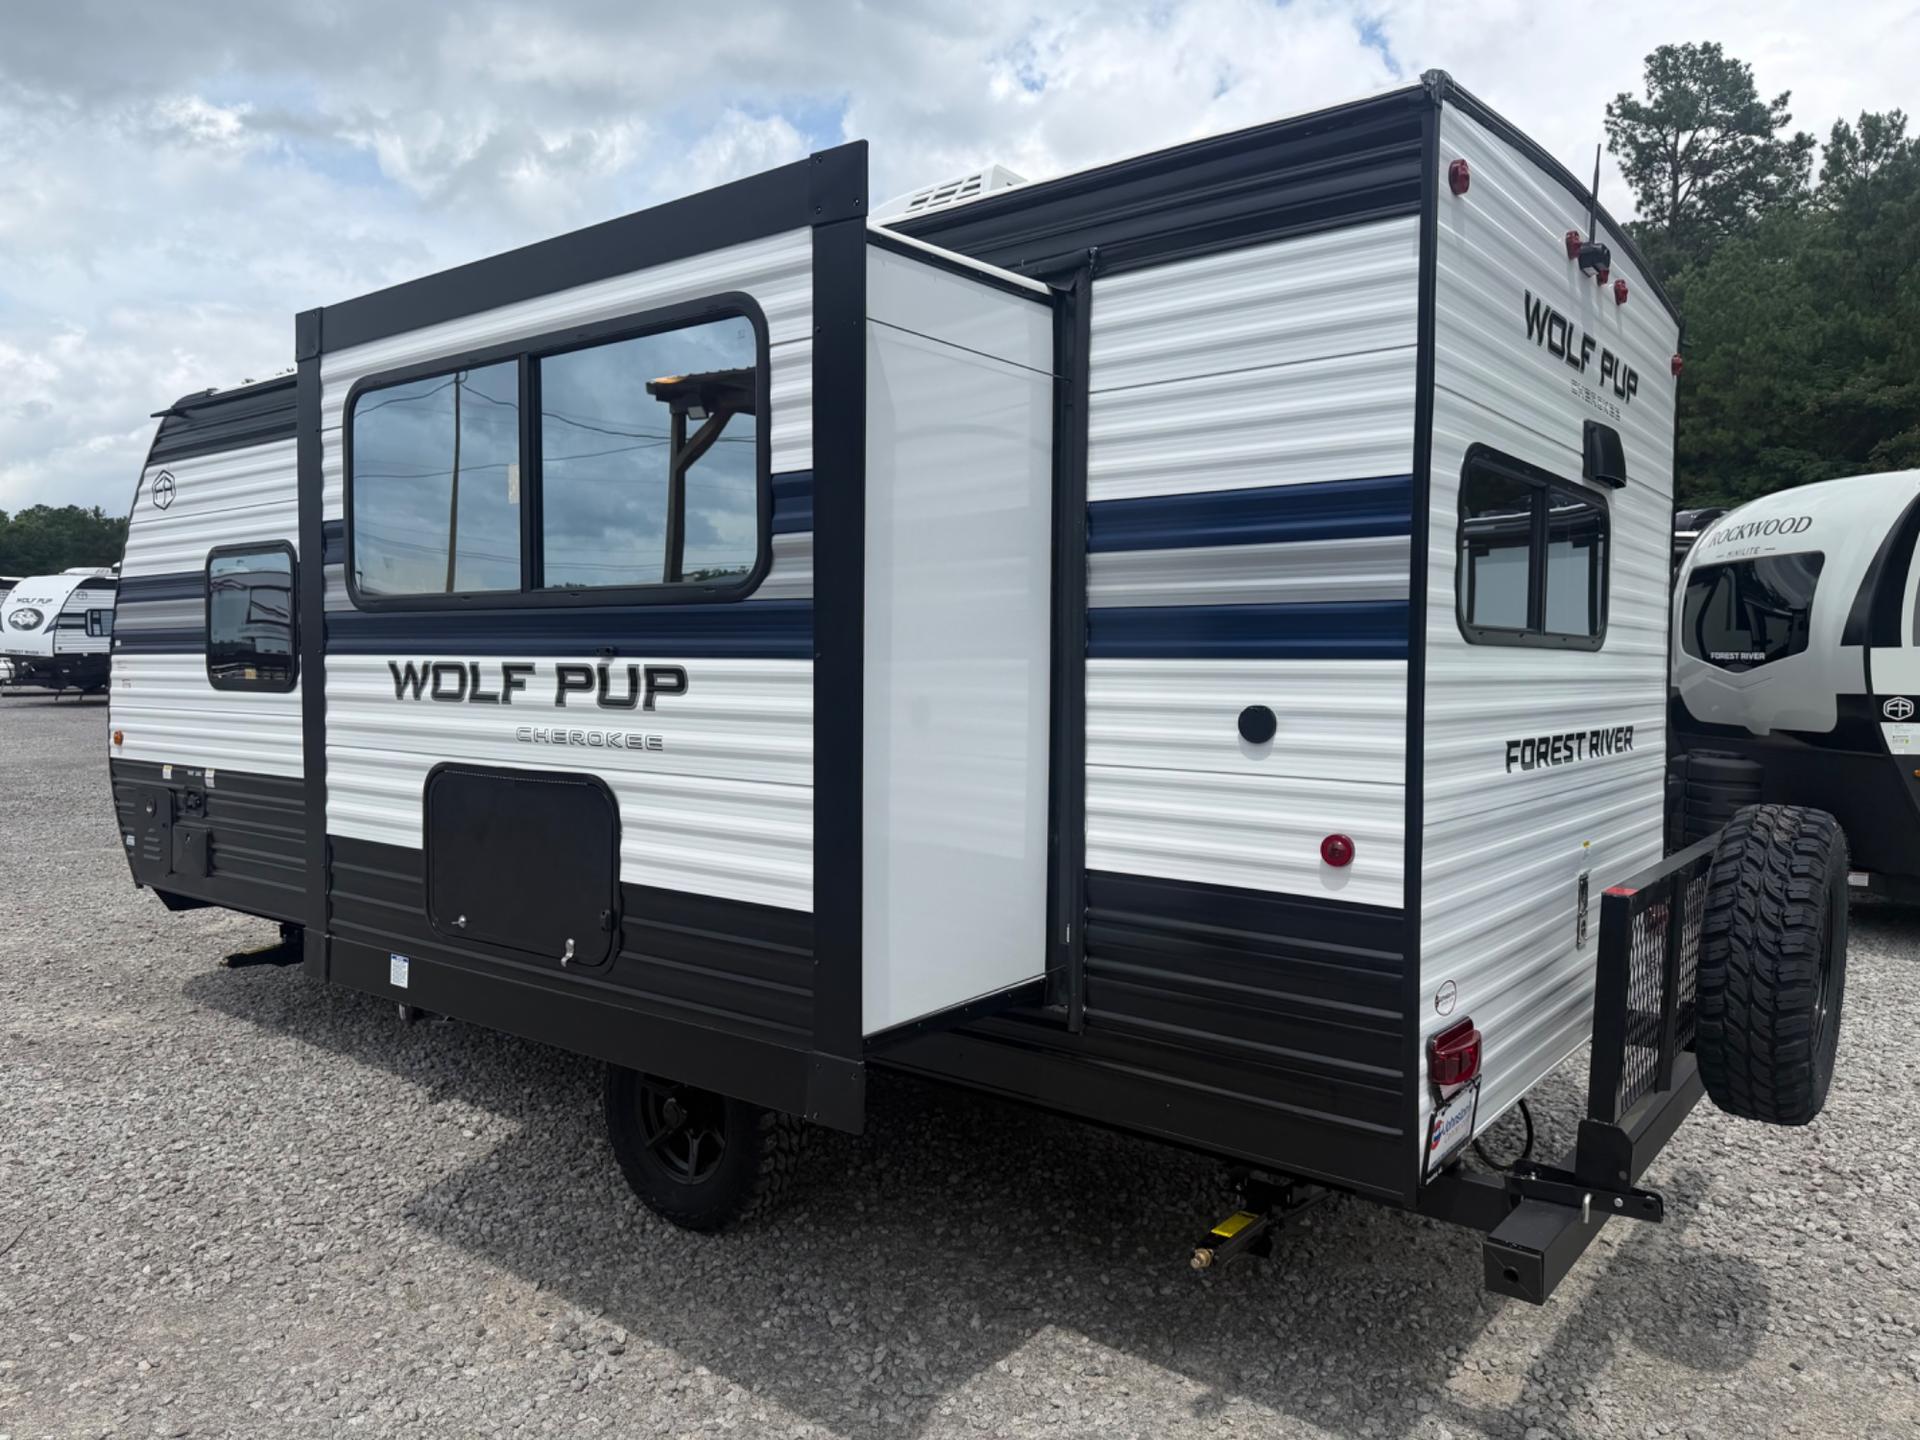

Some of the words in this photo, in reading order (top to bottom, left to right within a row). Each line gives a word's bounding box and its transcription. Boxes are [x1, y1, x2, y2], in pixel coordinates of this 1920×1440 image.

[1524, 288, 1596, 374] WOLF
[1598, 347, 1639, 404] PUP
[1708, 516, 1813, 548] ROCKWOOD
[1710, 651, 1740, 660] FOREST
[1740, 651, 1766, 660] RIVER
[387, 660, 537, 705] WOLF
[554, 662, 689, 711] PUP
[515, 727, 664, 751] CHEROKEE
[1505, 732, 1587, 773] FOREST
[1588, 725, 1634, 759] RIVER
